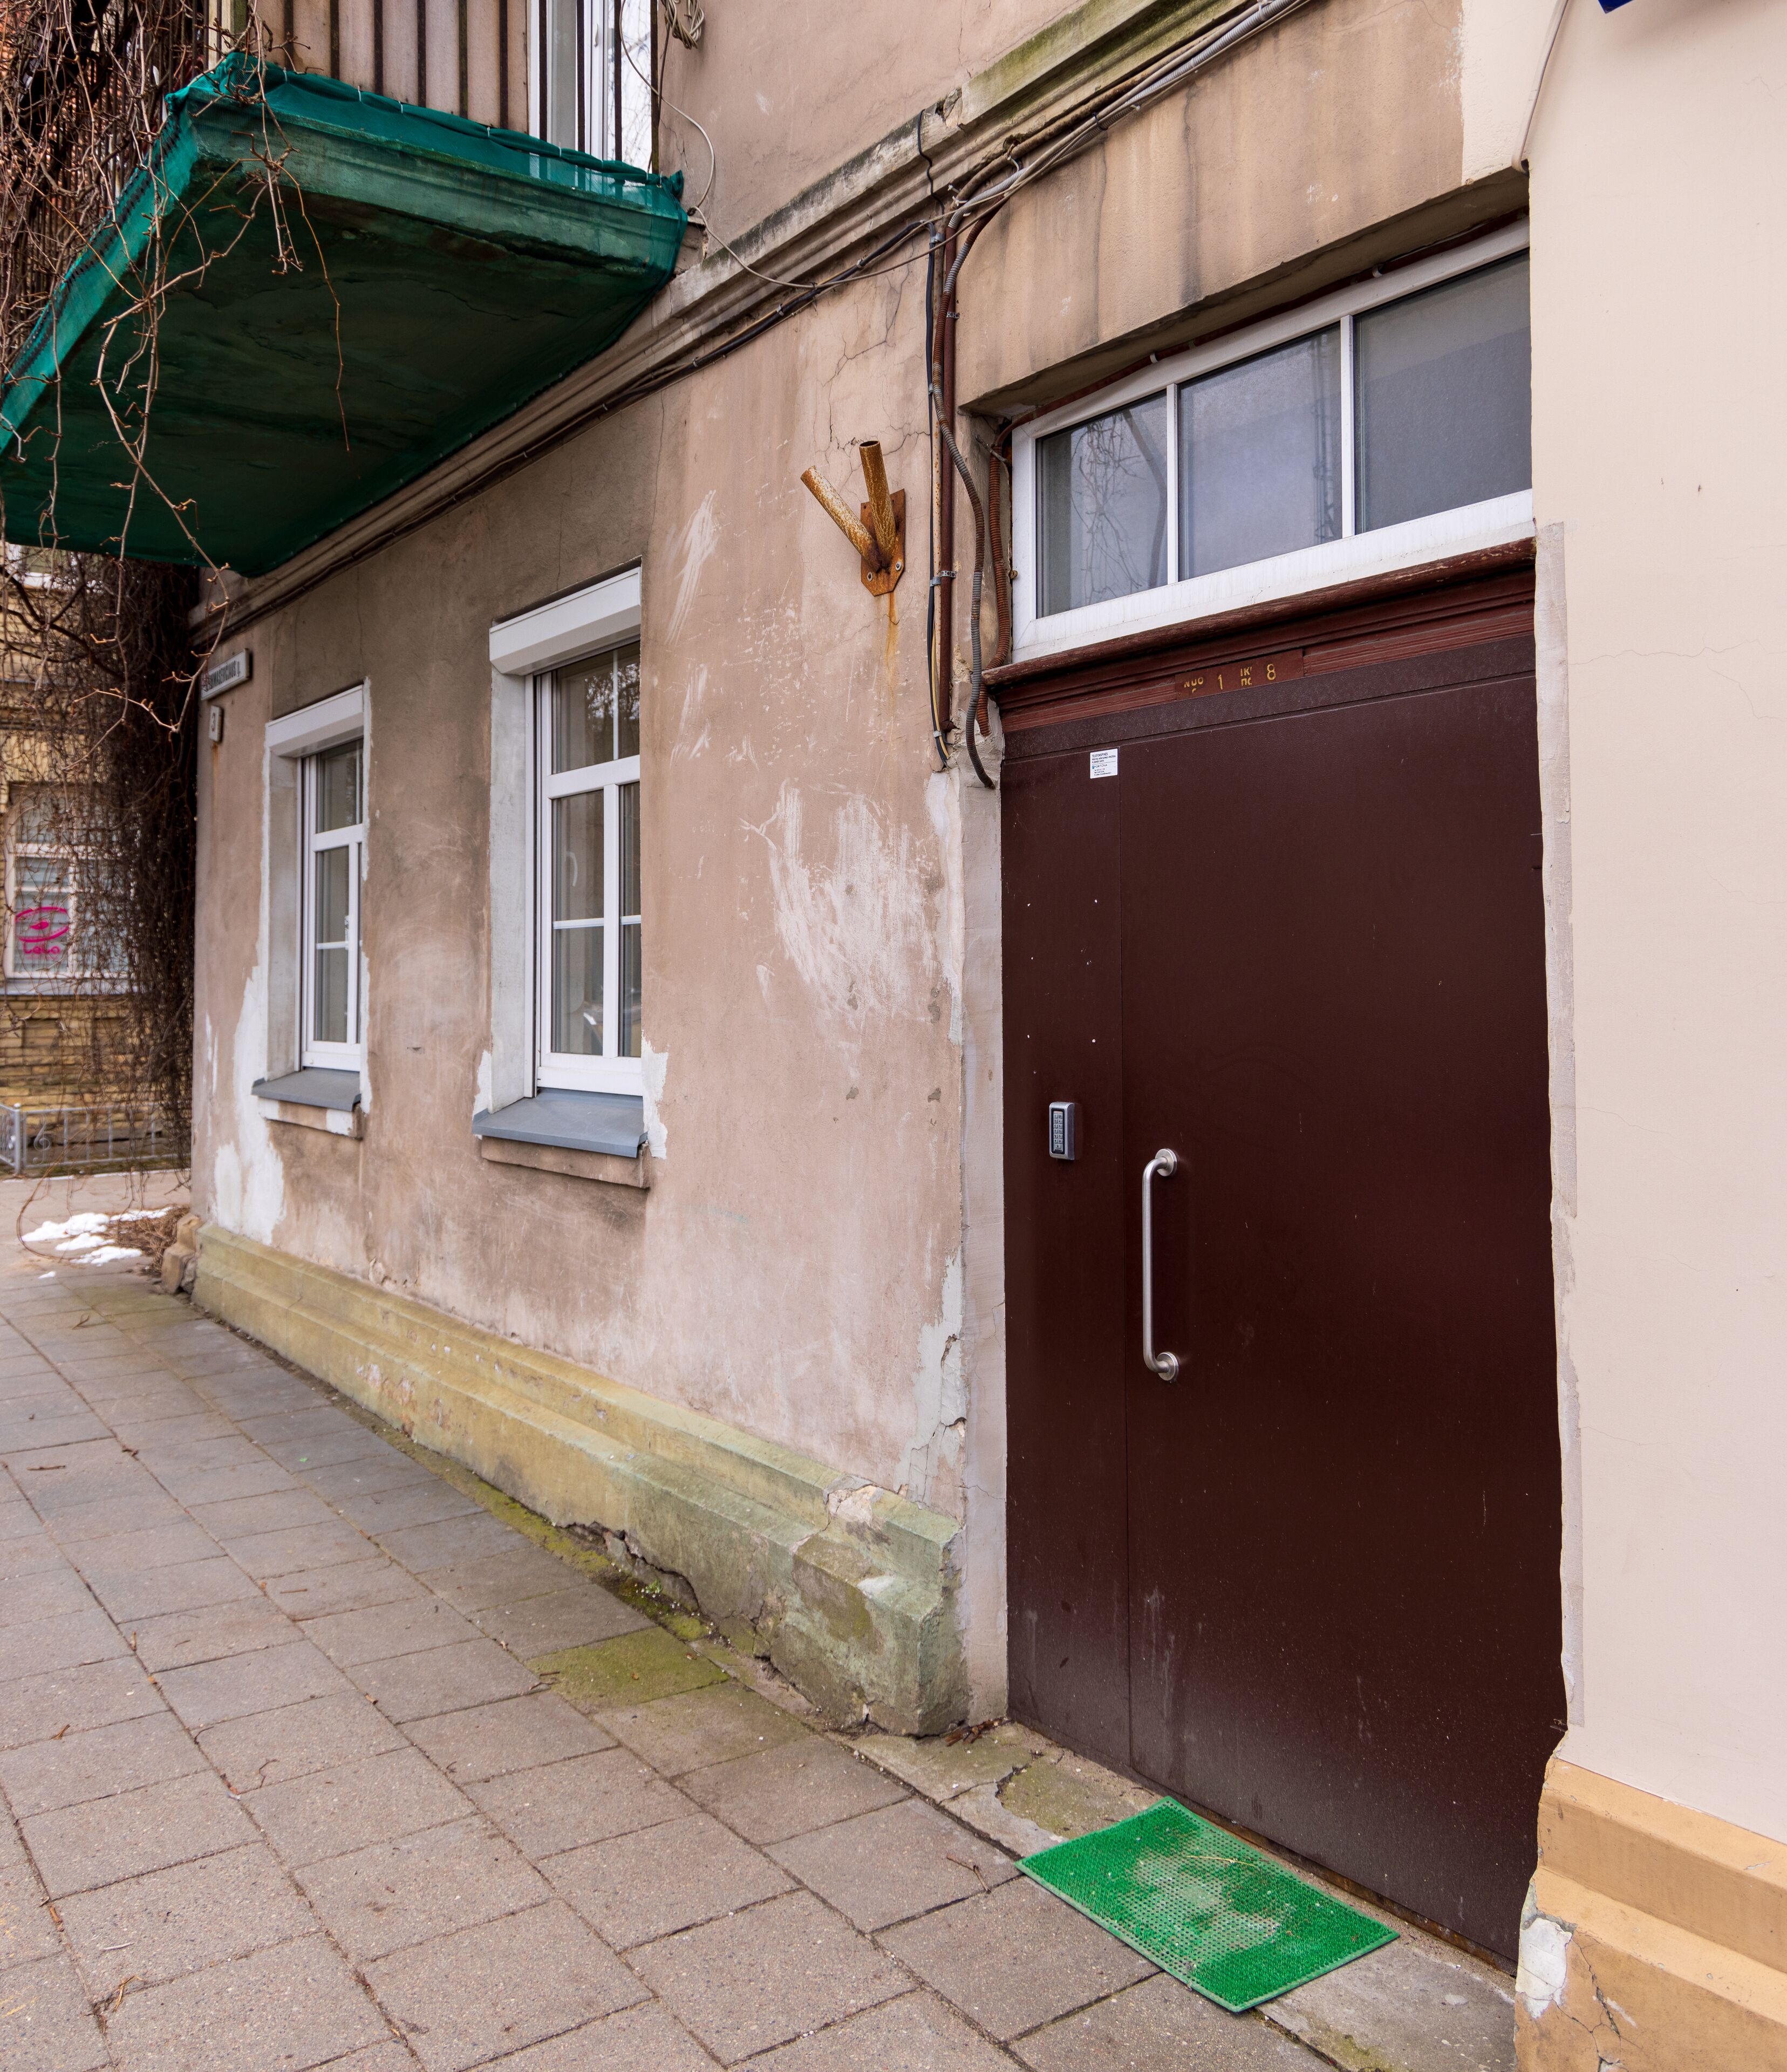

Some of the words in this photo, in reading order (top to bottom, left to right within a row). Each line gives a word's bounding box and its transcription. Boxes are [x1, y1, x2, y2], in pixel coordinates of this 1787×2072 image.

[1218, 674, 1223, 690] 1
[1267, 664, 1277, 680] 8
[211, 712, 216, 732] 3
